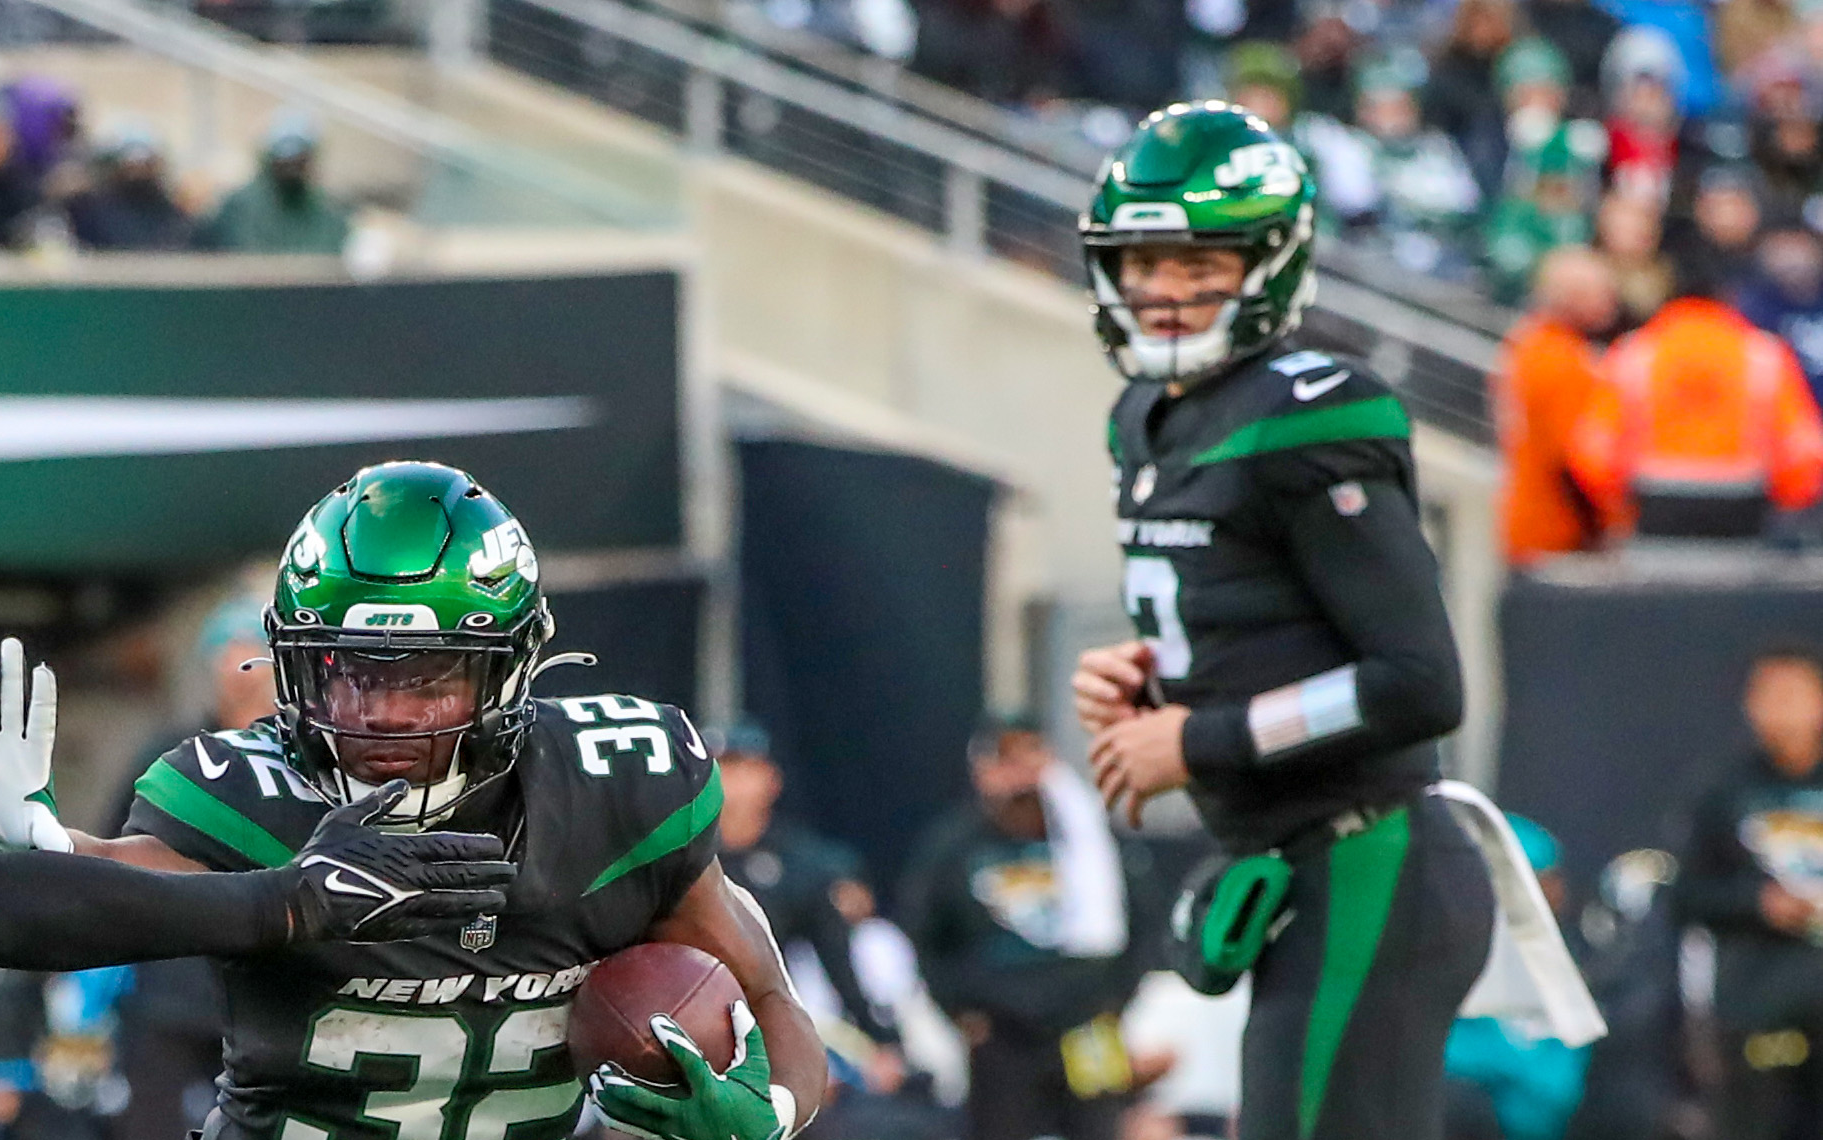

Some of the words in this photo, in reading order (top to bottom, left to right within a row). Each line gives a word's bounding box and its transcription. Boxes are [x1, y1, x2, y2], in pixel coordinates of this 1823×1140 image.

[364, 612, 415, 626] JETS
[559, 693, 675, 777] 32
[463, 930, 492, 946] NFL
[336, 973, 476, 1005] NEW
